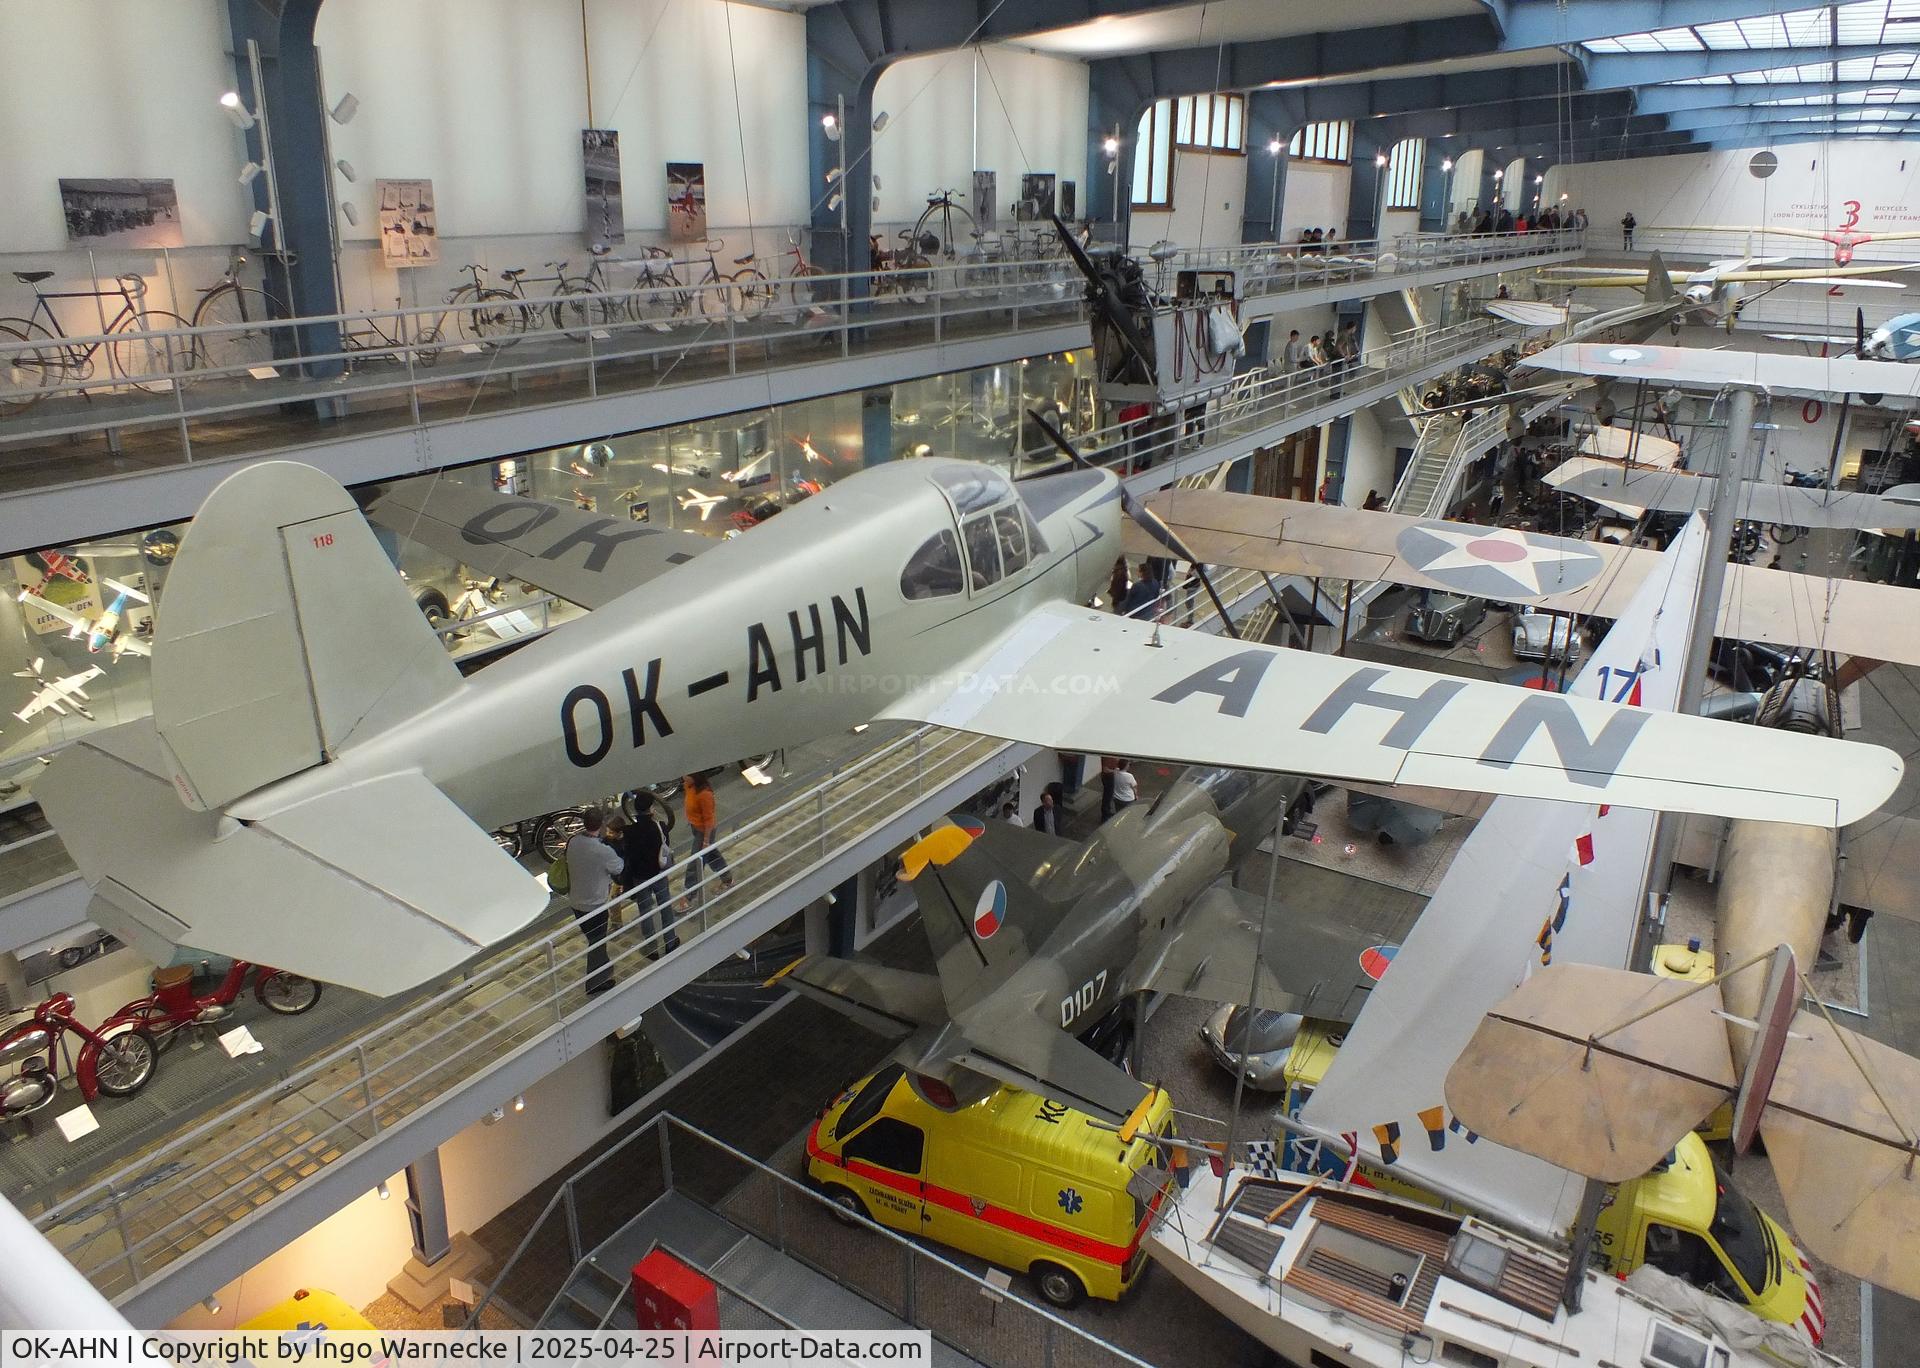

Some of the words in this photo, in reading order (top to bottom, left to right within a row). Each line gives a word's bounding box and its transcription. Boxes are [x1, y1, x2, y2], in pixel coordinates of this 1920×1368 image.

[1839, 201, 1861, 228] 3
[314, 533, 334, 549] 118
[561, 587, 871, 768] OK-AHN
[1598, 666, 1638, 703] 17
[1151, 649, 1653, 790] AHN
